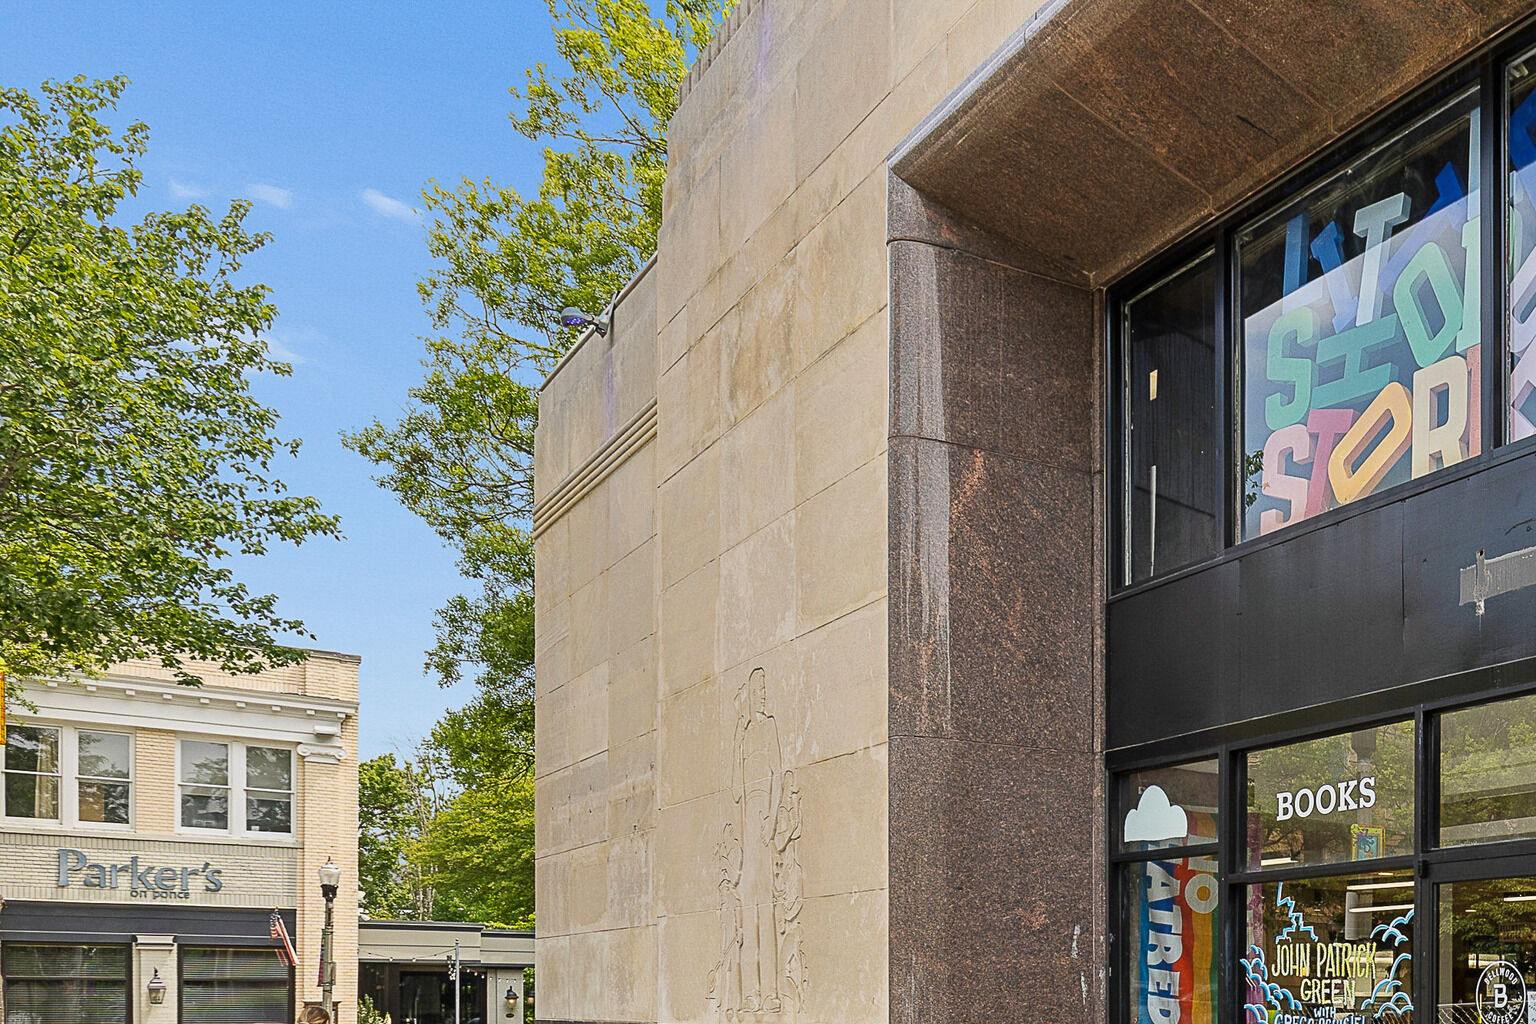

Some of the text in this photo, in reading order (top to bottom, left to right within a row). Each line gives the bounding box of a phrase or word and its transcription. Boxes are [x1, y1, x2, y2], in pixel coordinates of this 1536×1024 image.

[1276, 776, 1376, 822] BOOKS
[58, 848, 223, 893] Parker's
[130, 890, 190, 900] on ponce
[1271, 941, 1377, 979] JOHN PATRICK
[1300, 978, 1356, 1010] GREEN
[1493, 983, 1508, 1008] B
[1313, 1006, 1337, 1019] WITH
